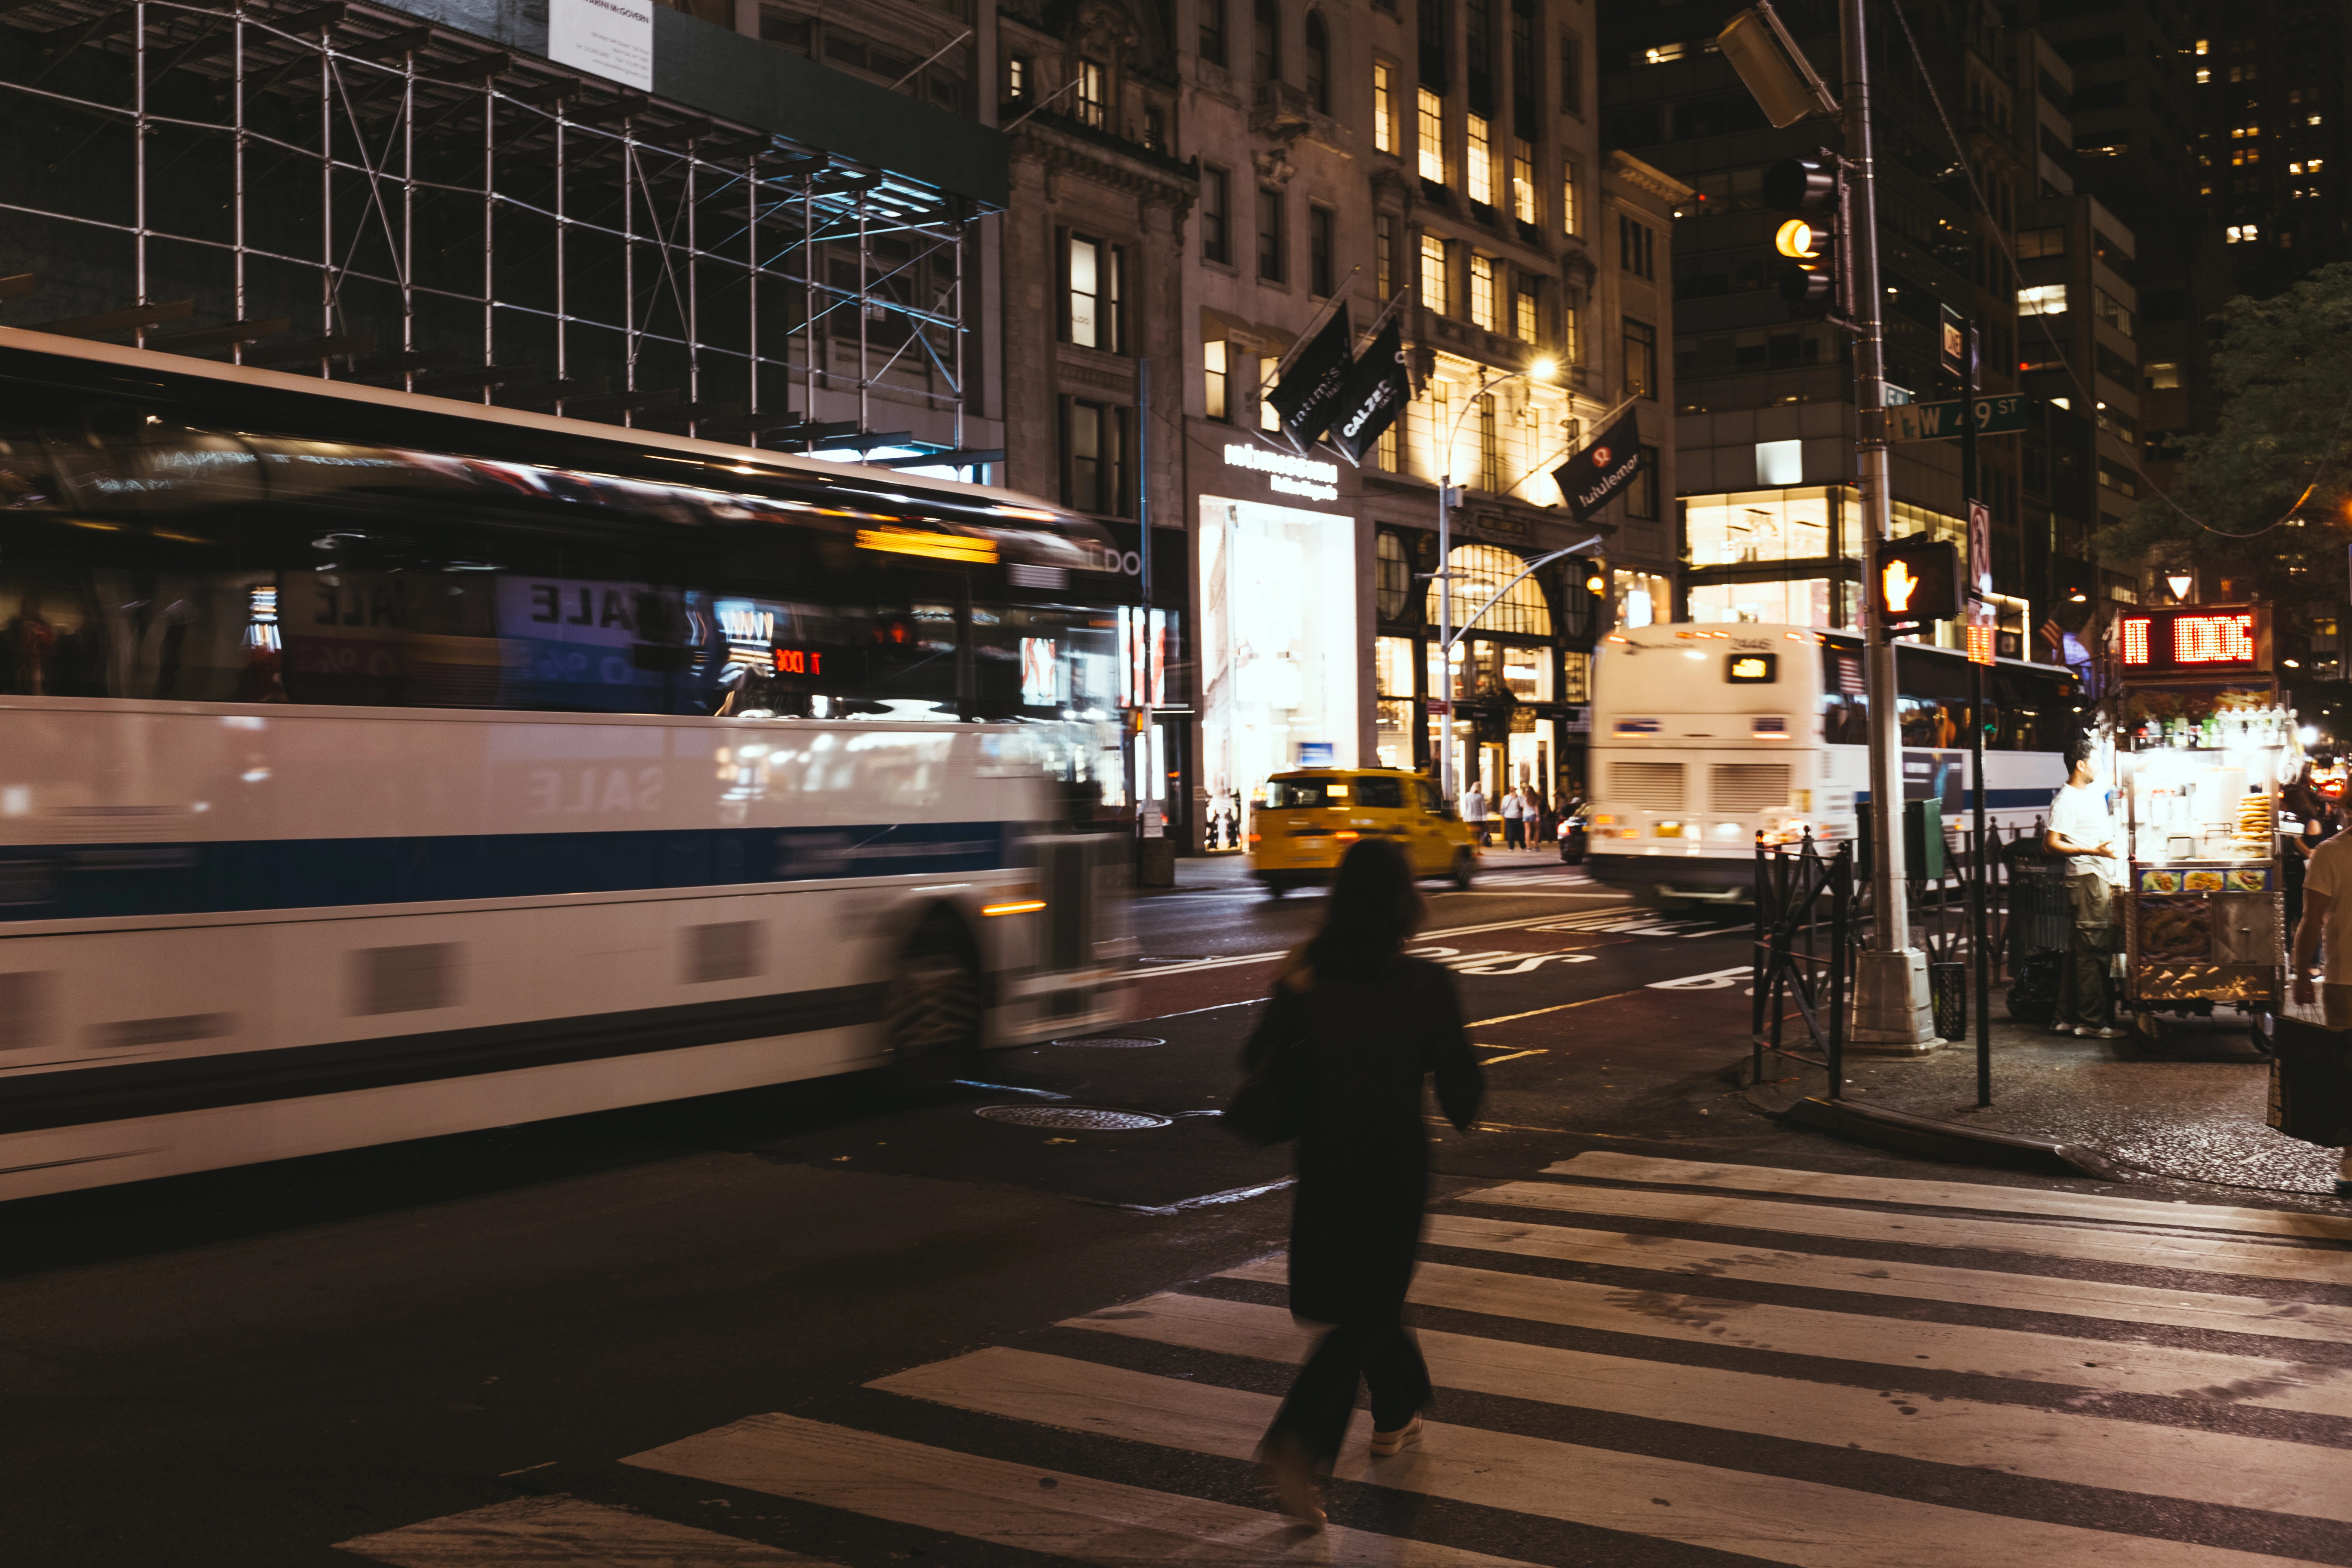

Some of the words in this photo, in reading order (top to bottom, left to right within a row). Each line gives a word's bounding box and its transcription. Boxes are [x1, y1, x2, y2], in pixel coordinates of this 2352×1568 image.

[610, 4, 649, 23] McGOVERN
[1919, 407, 1941, 435] W
[1997, 399, 2018, 414] ST
